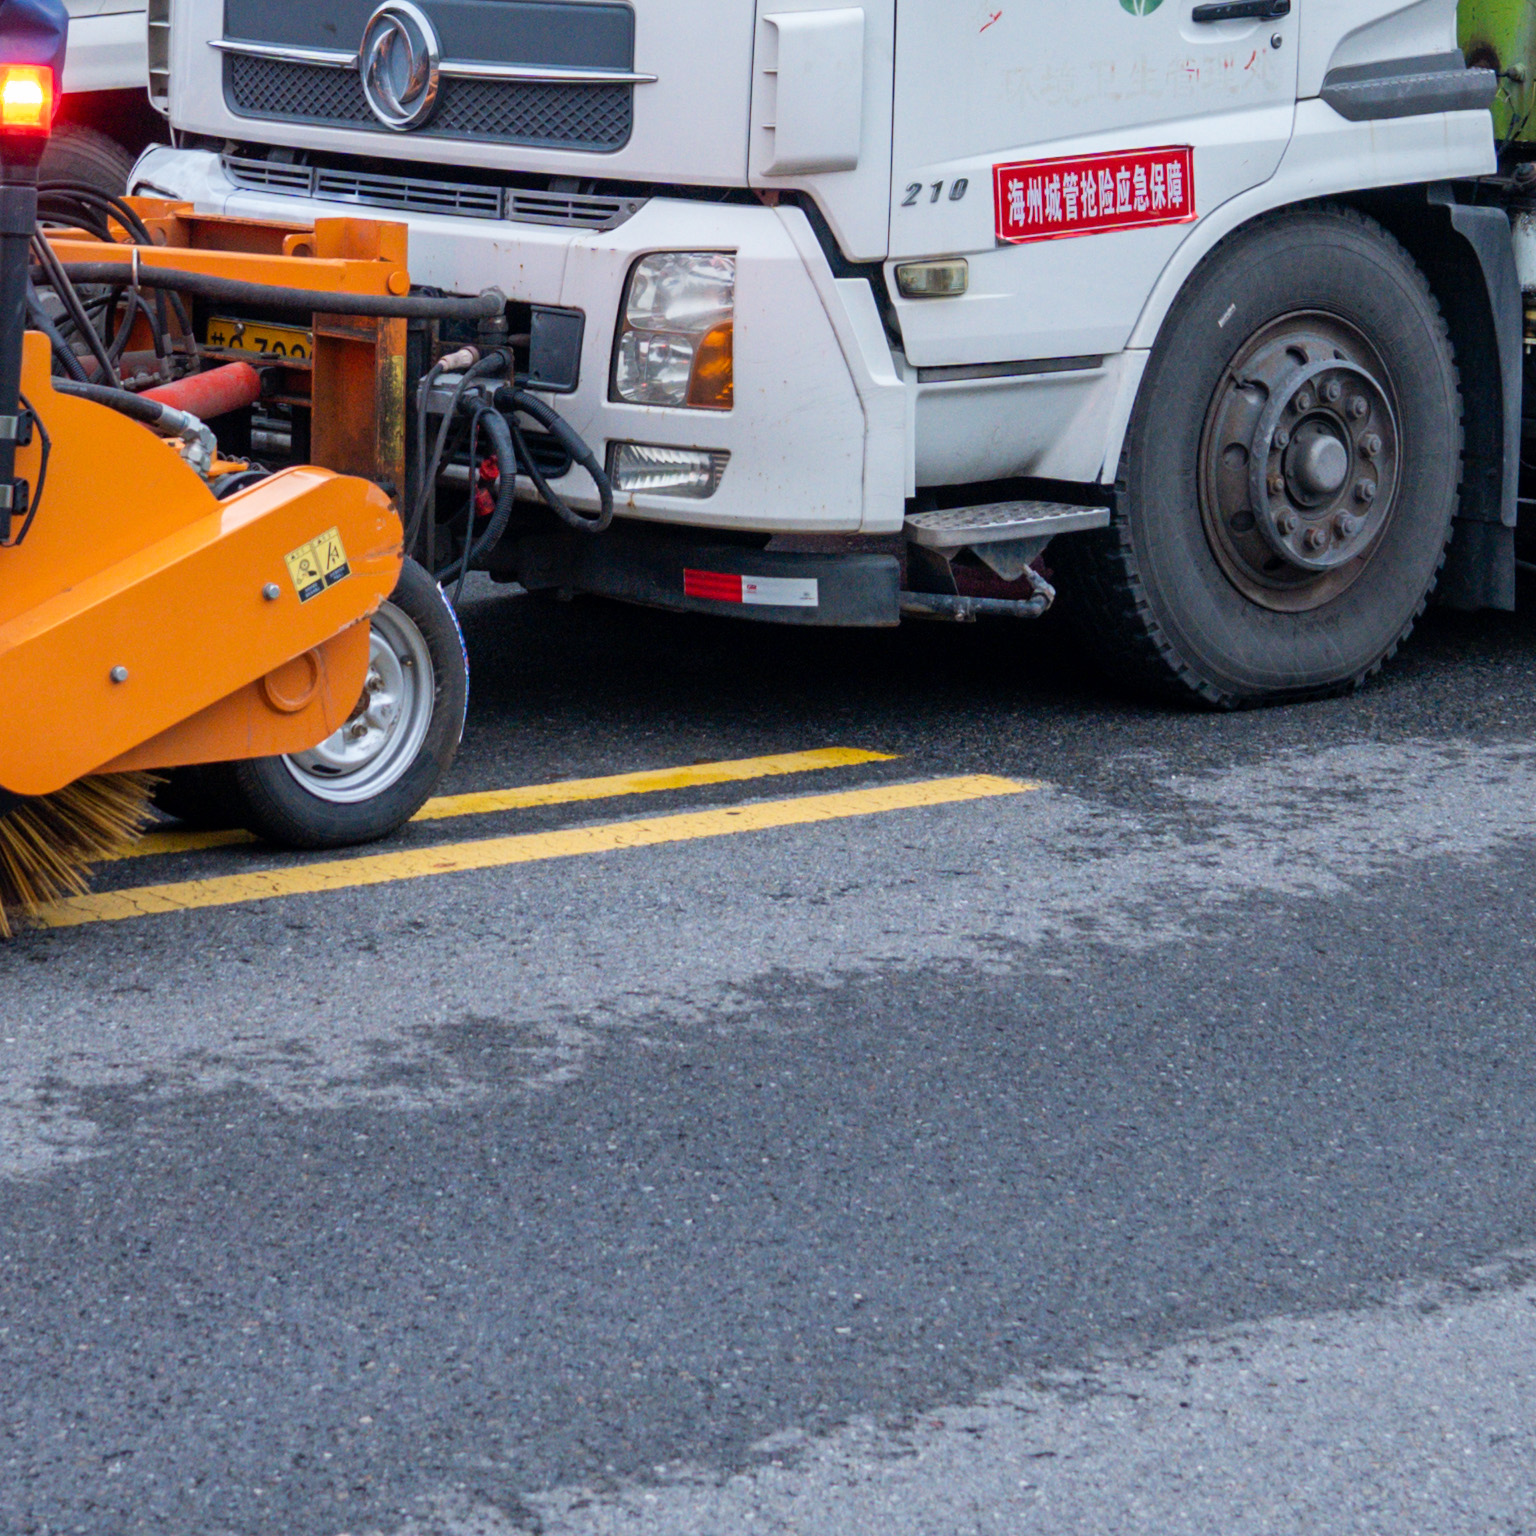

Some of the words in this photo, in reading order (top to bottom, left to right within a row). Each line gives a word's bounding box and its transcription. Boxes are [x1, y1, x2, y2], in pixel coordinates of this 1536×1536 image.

[901, 178, 969, 207] 210
[1008, 160, 1184, 229] 海州城管抢险应急保障
